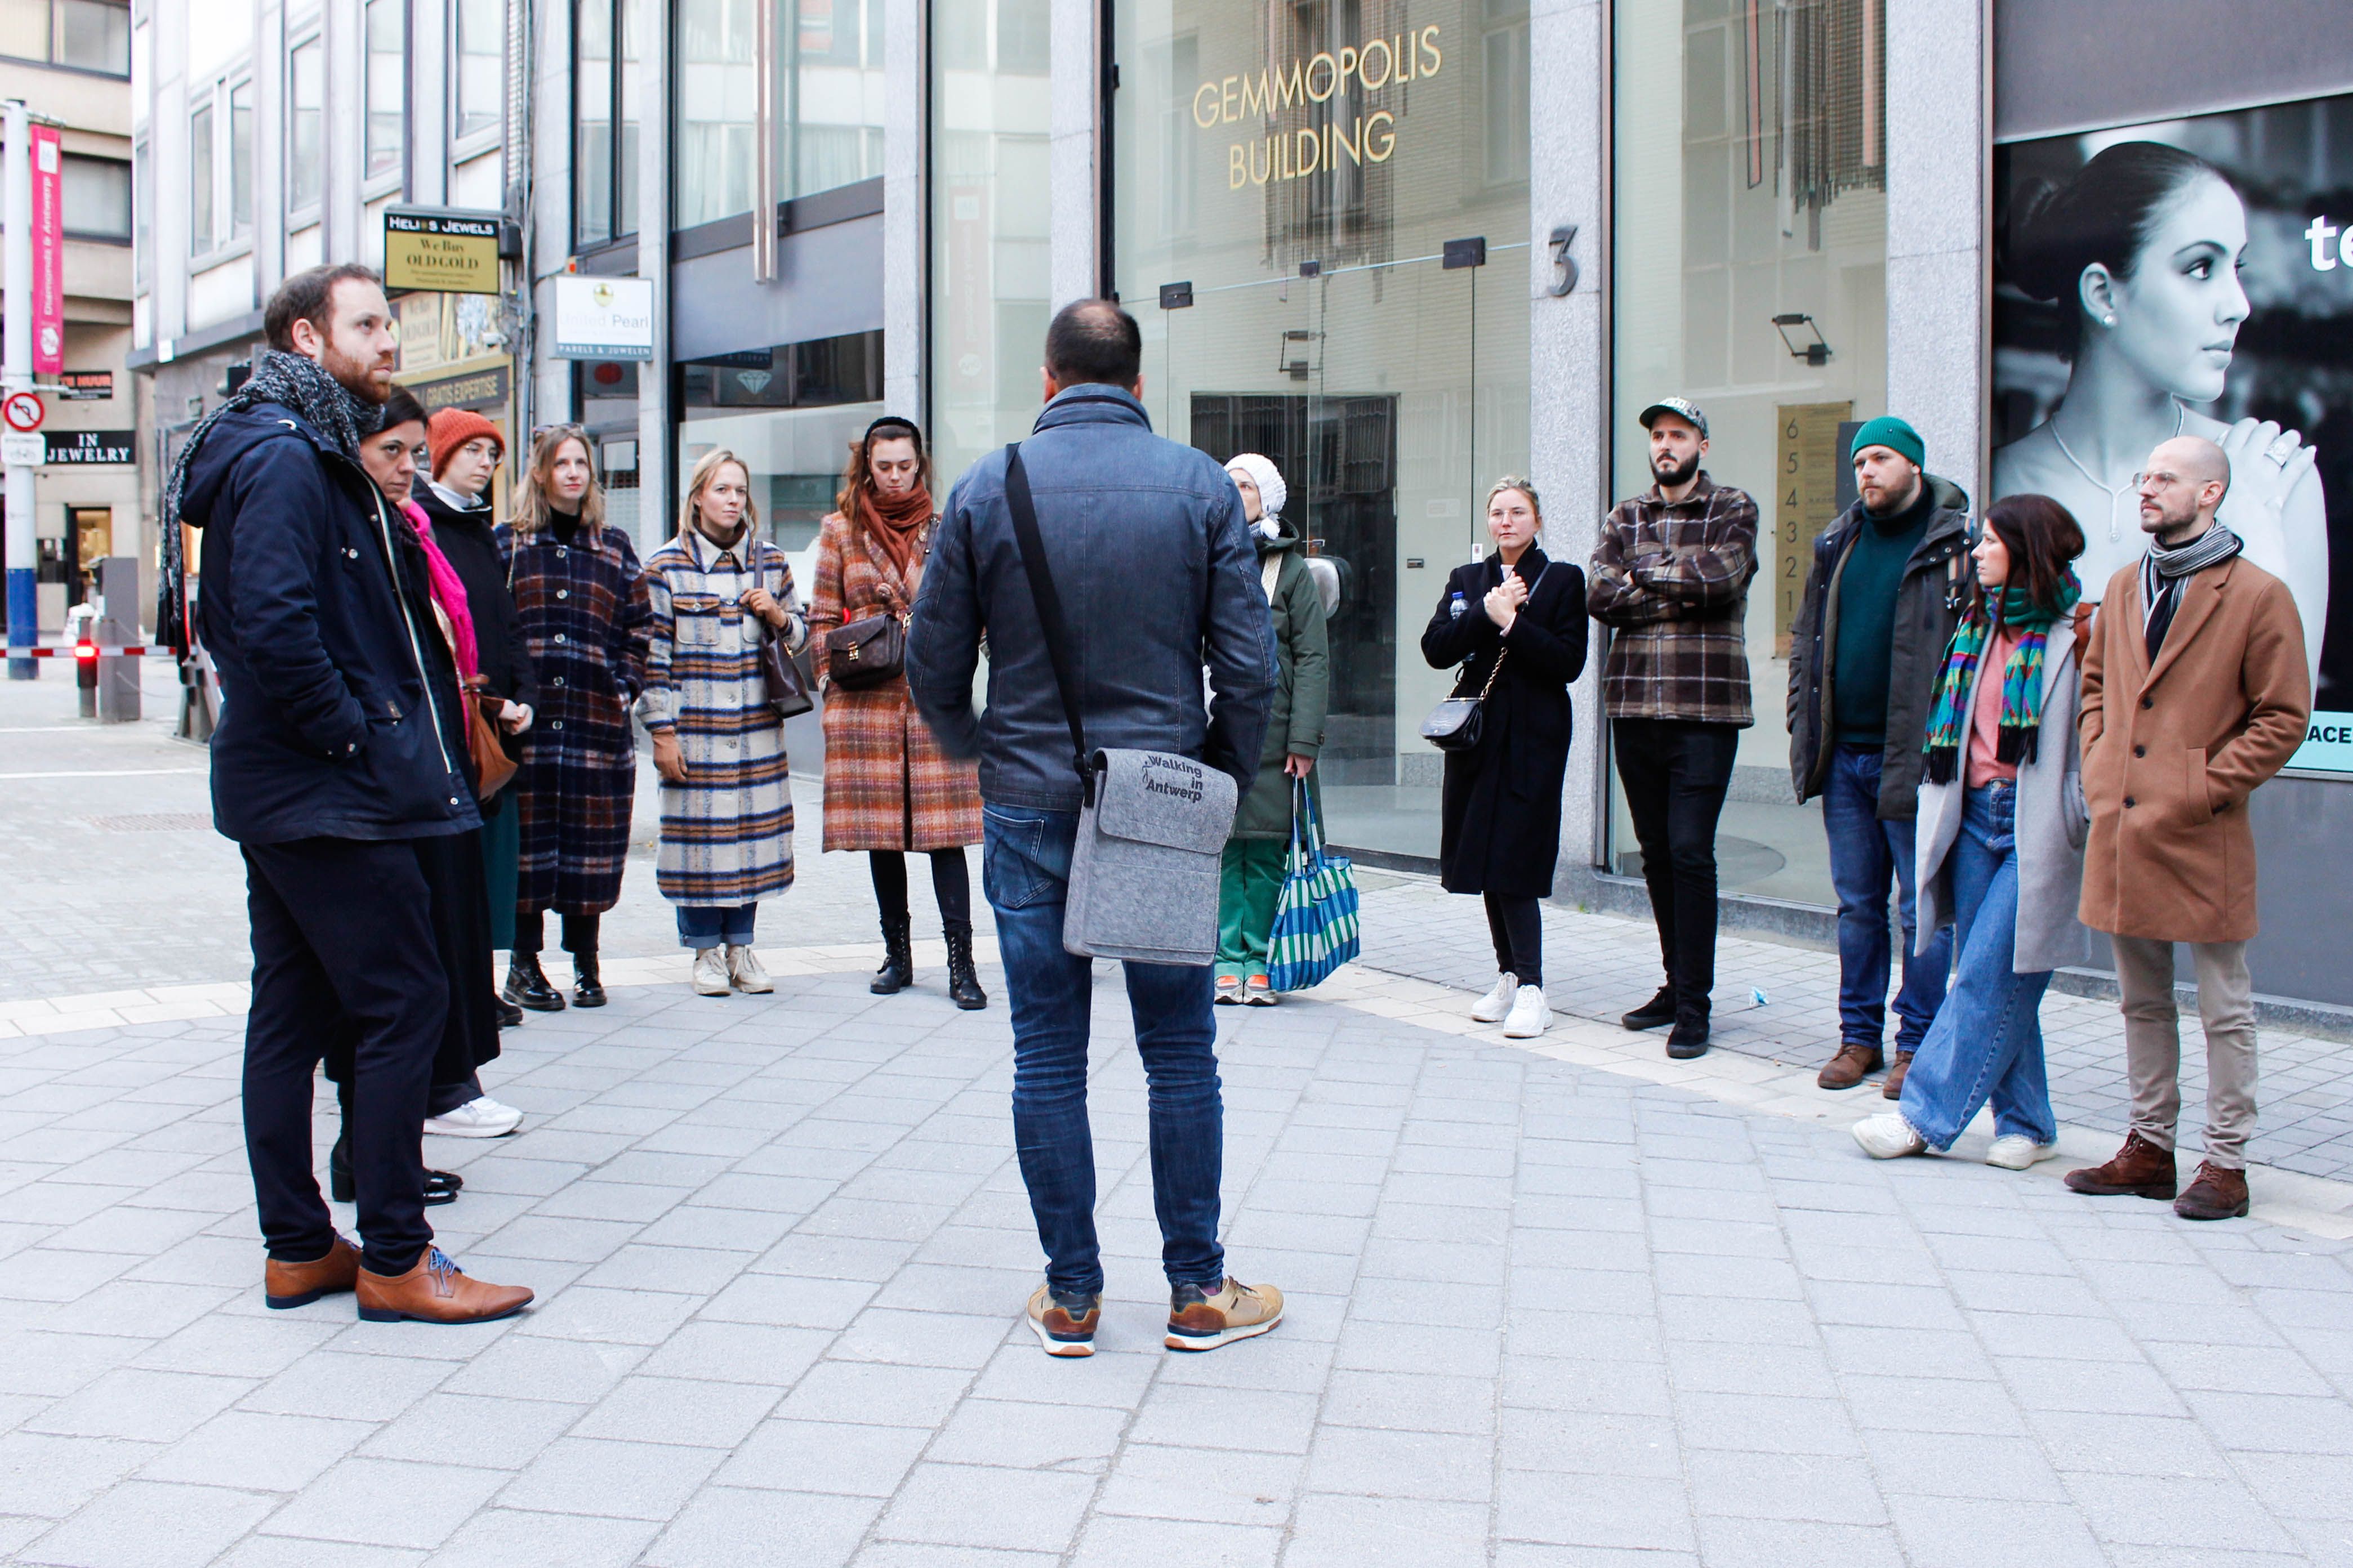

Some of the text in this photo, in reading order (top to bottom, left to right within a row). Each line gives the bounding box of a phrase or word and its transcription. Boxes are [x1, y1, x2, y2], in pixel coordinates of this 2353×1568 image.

[1193, 24, 1442, 129] GEMMOPOLIS
[1229, 110, 1396, 190] BUILDING
[442, 220, 494, 235] JEWELS
[420, 238, 439, 251] We
[407, 254, 479, 270] OLD GOLD
[1548, 225, 1579, 297] 3
[612, 314, 649, 329] Pearl
[559, 345, 594, 354] PARELS
[608, 347, 650, 356] JUWELEN
[1786, 417, 1798, 439] 6
[78, 433, 98, 446] IN
[47, 447, 130, 462] JEWELRY
[1786, 452, 1798, 473] 5
[1785, 488, 1798, 508] 4
[1786, 521, 1797, 543] 3
[1785, 556, 1797, 578] 2
[1787, 591, 1793, 612] 1
[1147, 755, 1203, 779] Walking
[1146, 779, 1203, 803] Antwerp
[1191, 776, 1204, 791] in
